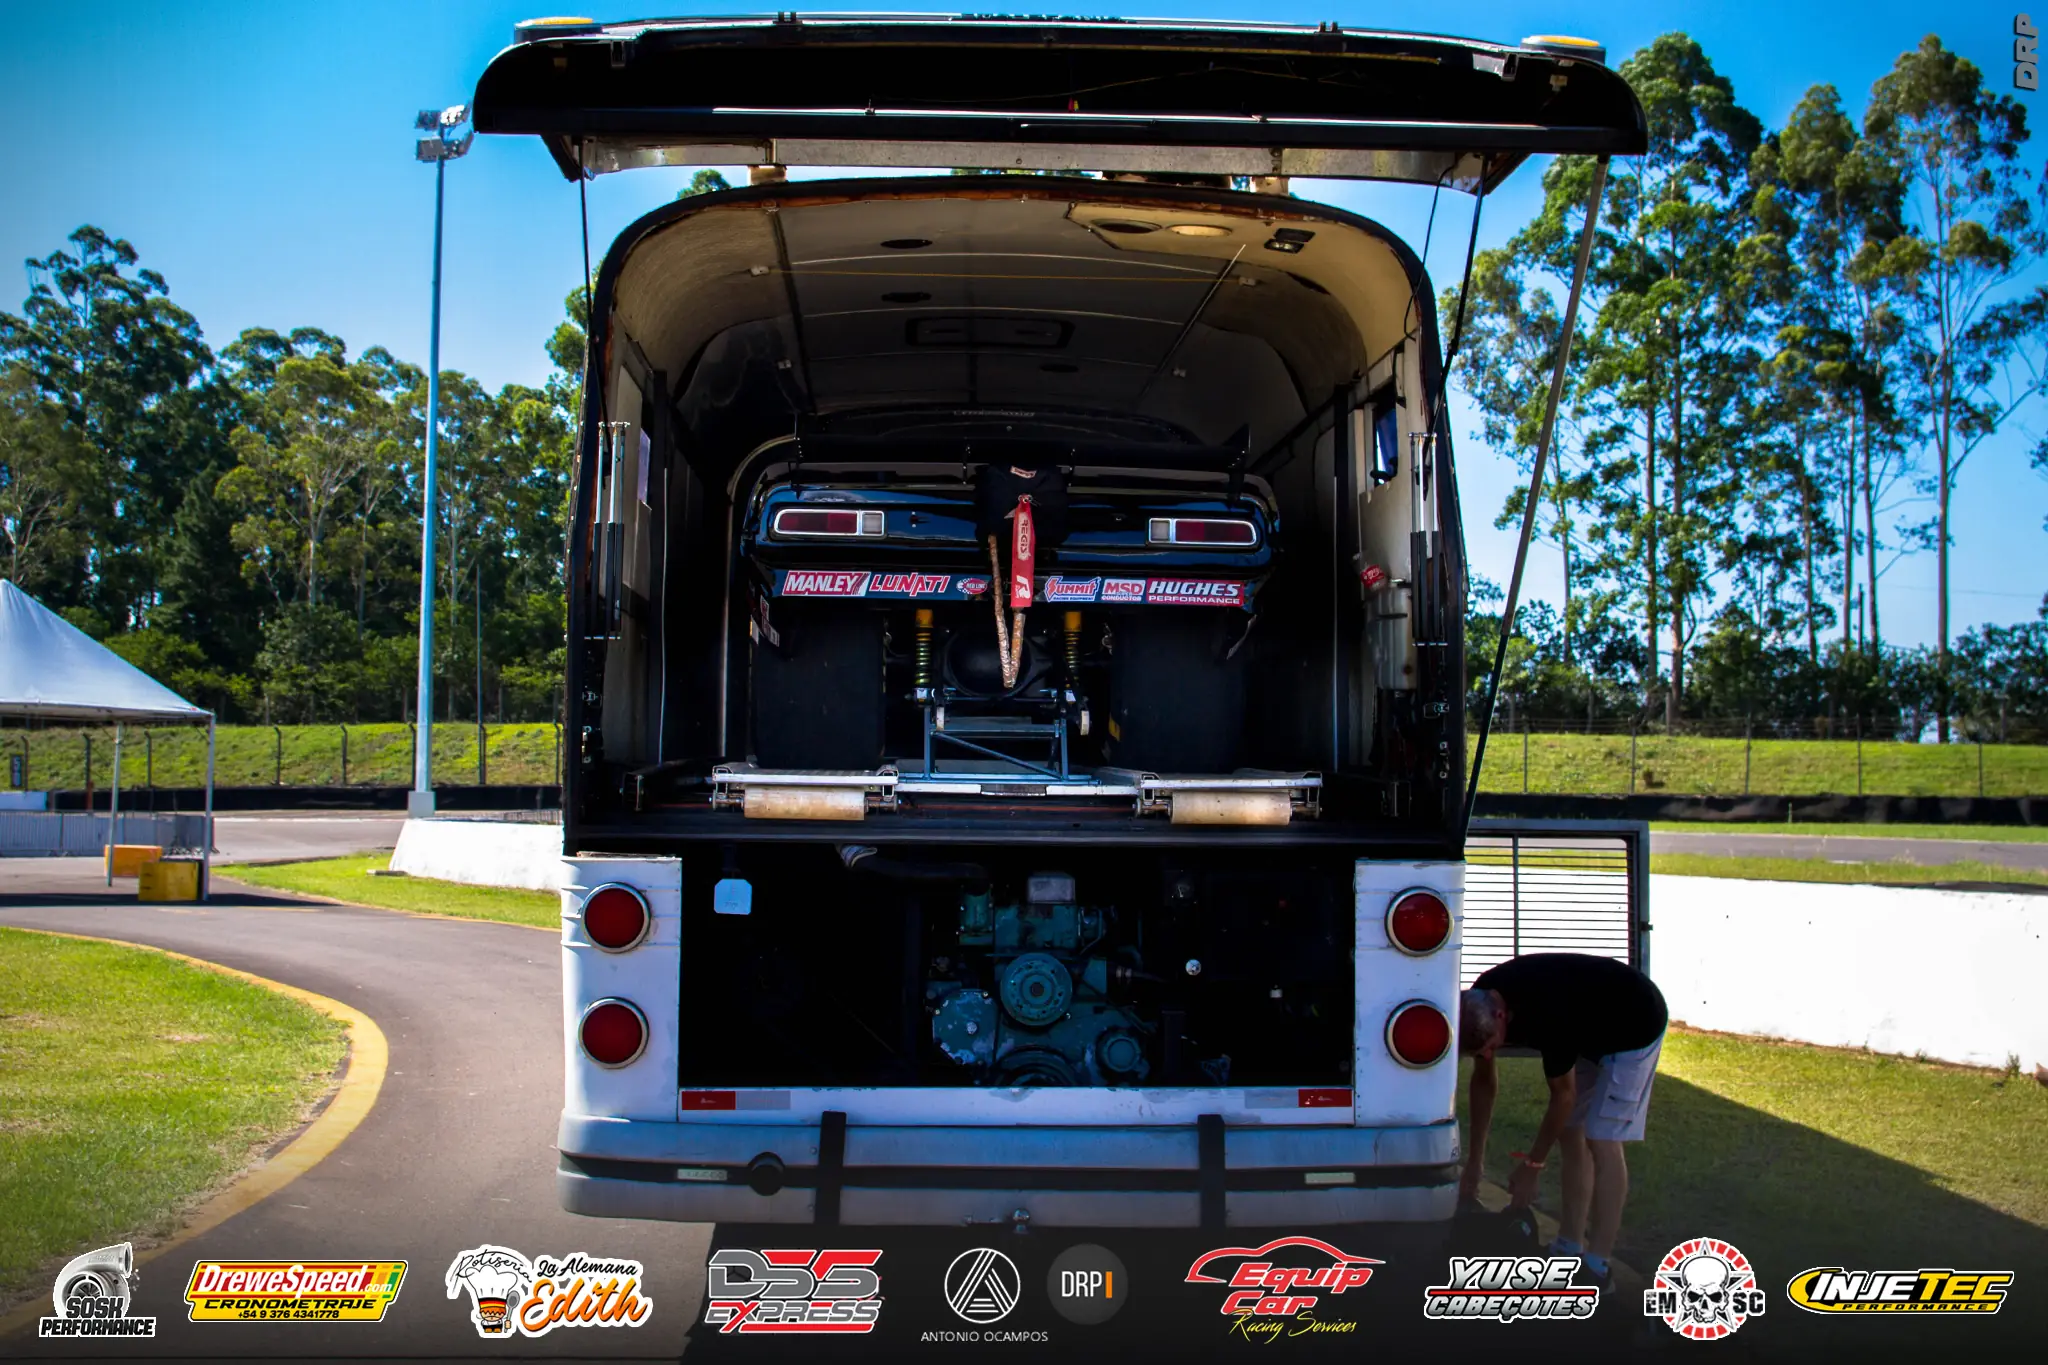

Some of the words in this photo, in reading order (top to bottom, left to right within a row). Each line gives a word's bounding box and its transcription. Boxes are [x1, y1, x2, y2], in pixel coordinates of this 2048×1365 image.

[786, 574, 858, 593] MANLEY
[869, 572, 951, 597] LUNATI
[1104, 582, 1143, 595] MSD
[1149, 580, 1241, 597] HUGHES
[1148, 595, 1241, 604] PERFORMANCE
